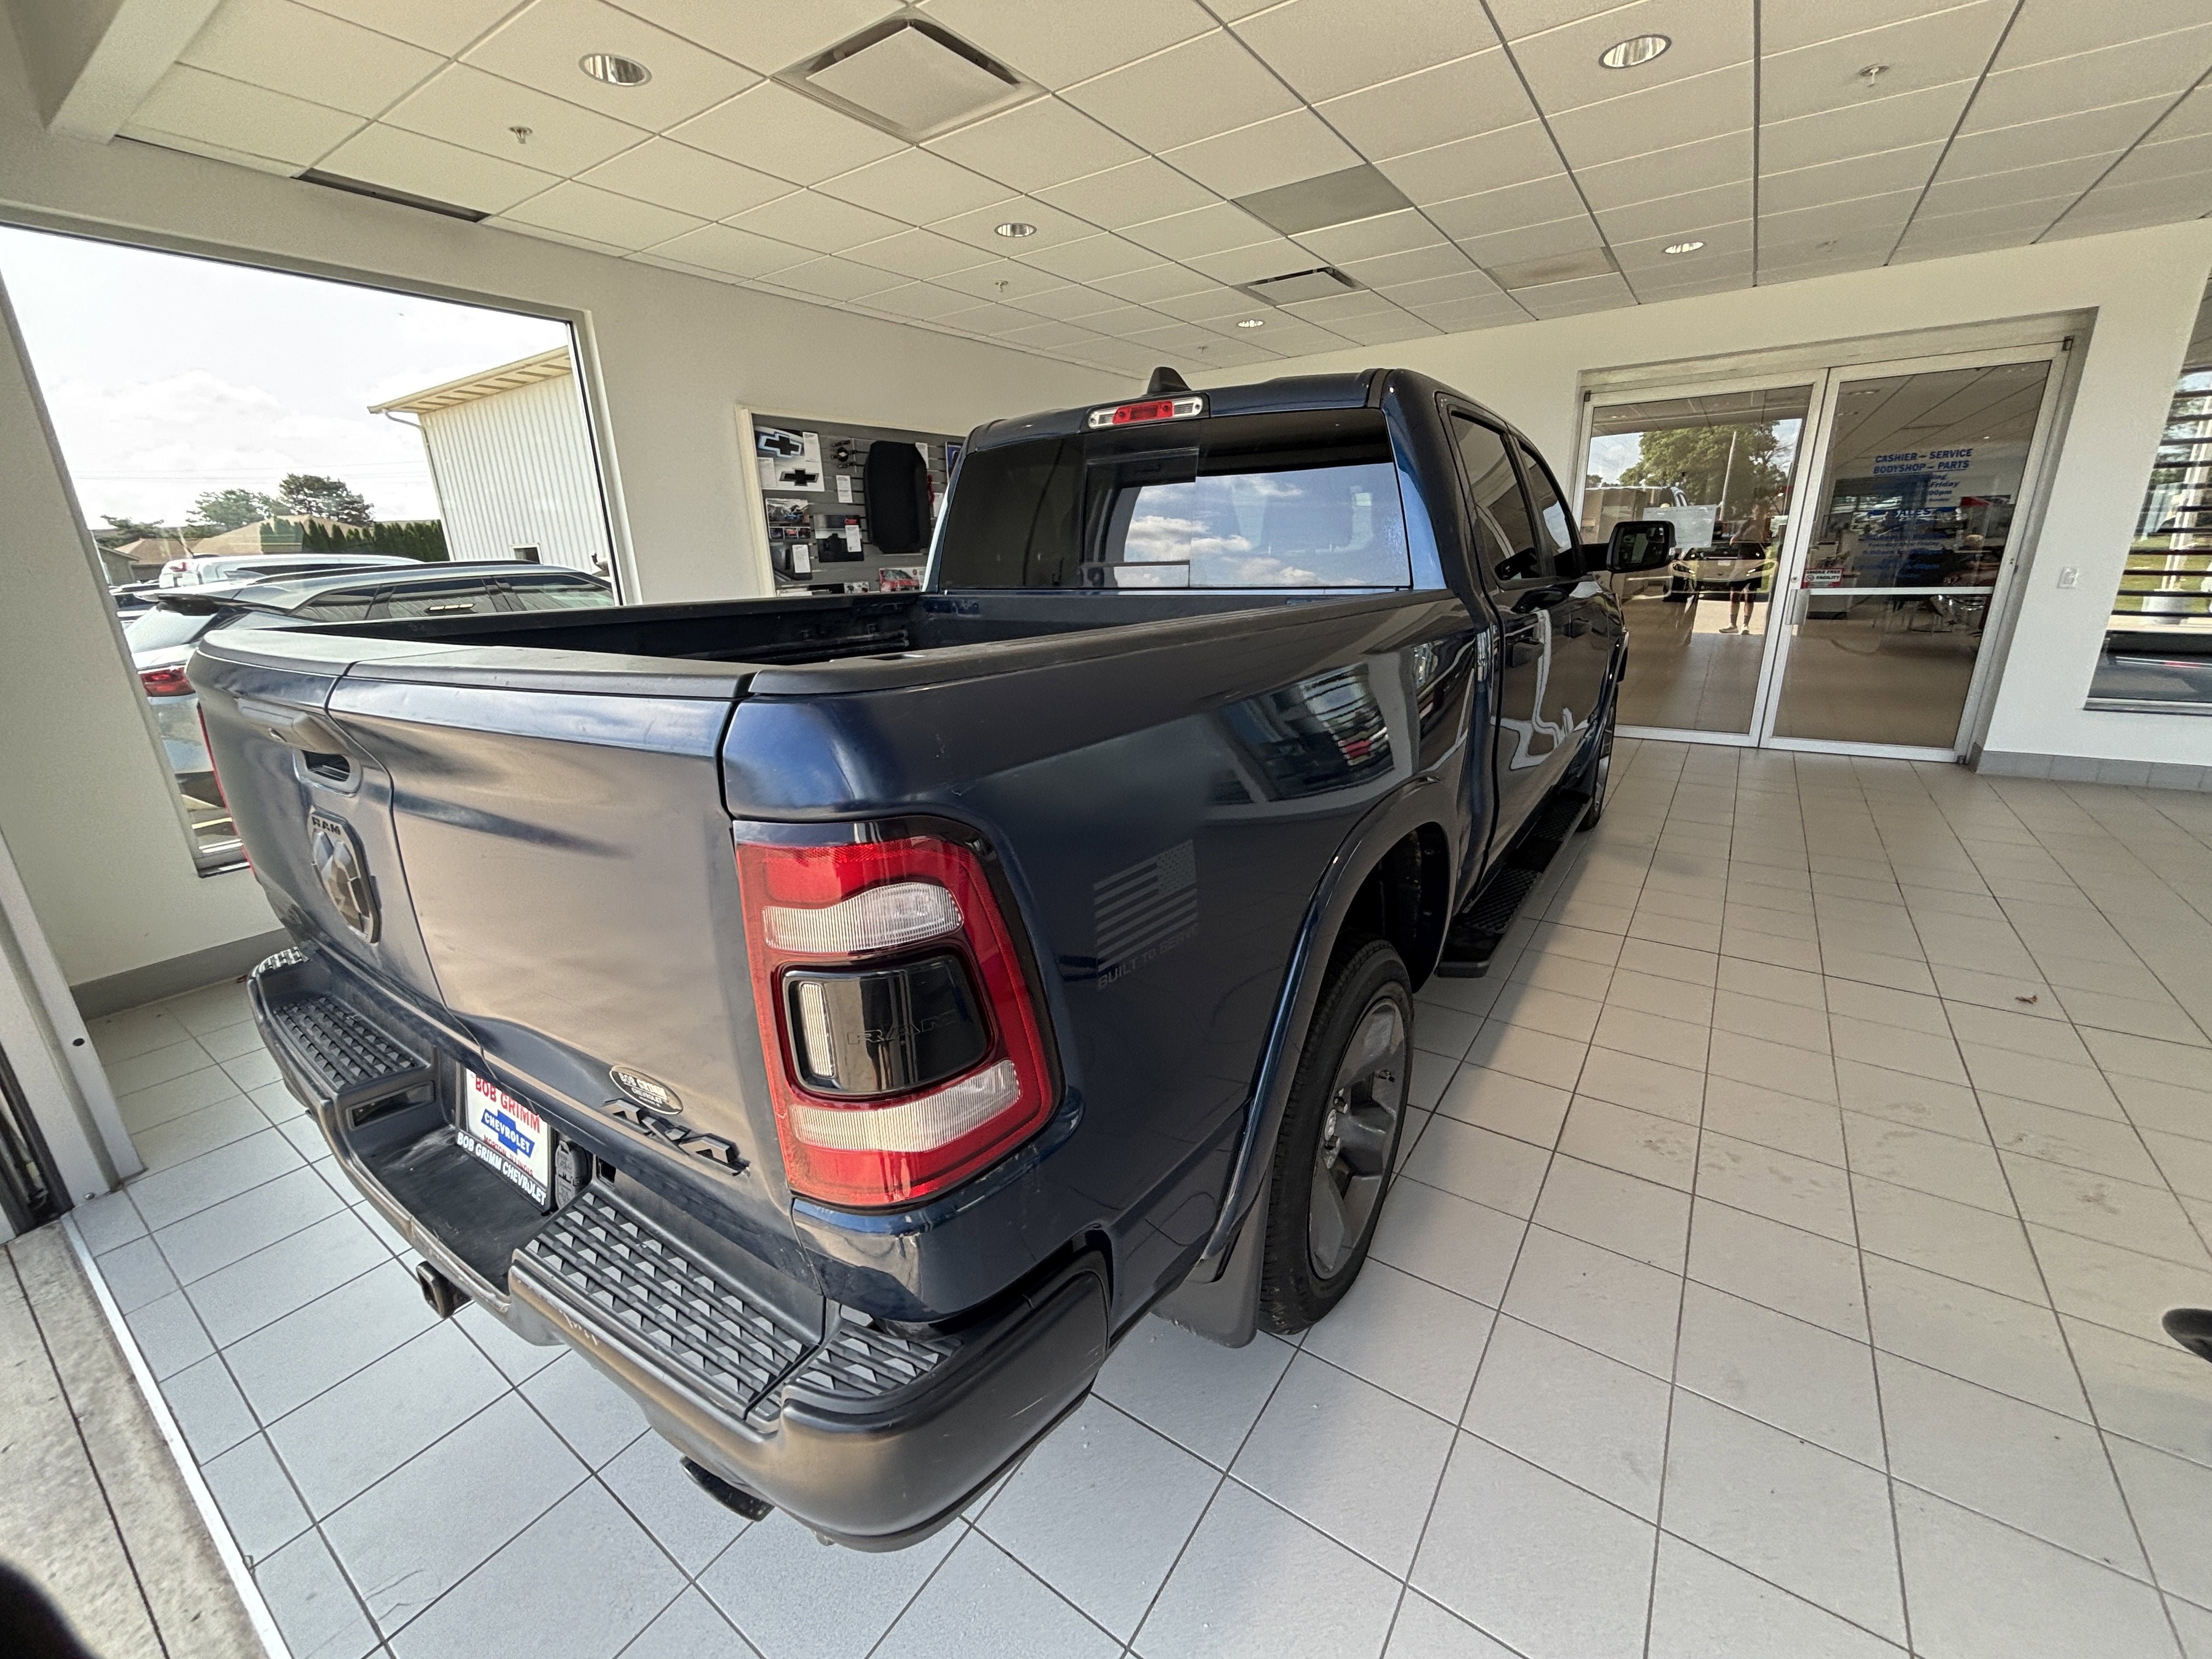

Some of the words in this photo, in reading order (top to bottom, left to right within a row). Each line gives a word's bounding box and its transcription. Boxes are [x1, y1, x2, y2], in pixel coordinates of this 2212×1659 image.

[1873, 463, 1926, 474] BODYSHOP
[1938, 460, 1970, 470] PARTS
[1876, 453, 1917, 463] CASHIER
[1929, 449, 1973, 459] SERVICE
[312, 816, 341, 835] RAM
[1098, 957, 1139, 990] BUILT
[848, 1008, 957, 1045] RAM
[475, 1076, 497, 1103] BOB
[500, 1092, 540, 1133] GRIMM
[484, 1112, 531, 1153] CHEVROLET
[456, 1132, 475, 1152] BOB
[475, 1142, 502, 1171] GRIMM
[503, 1161, 546, 1206] CHEVROLET
